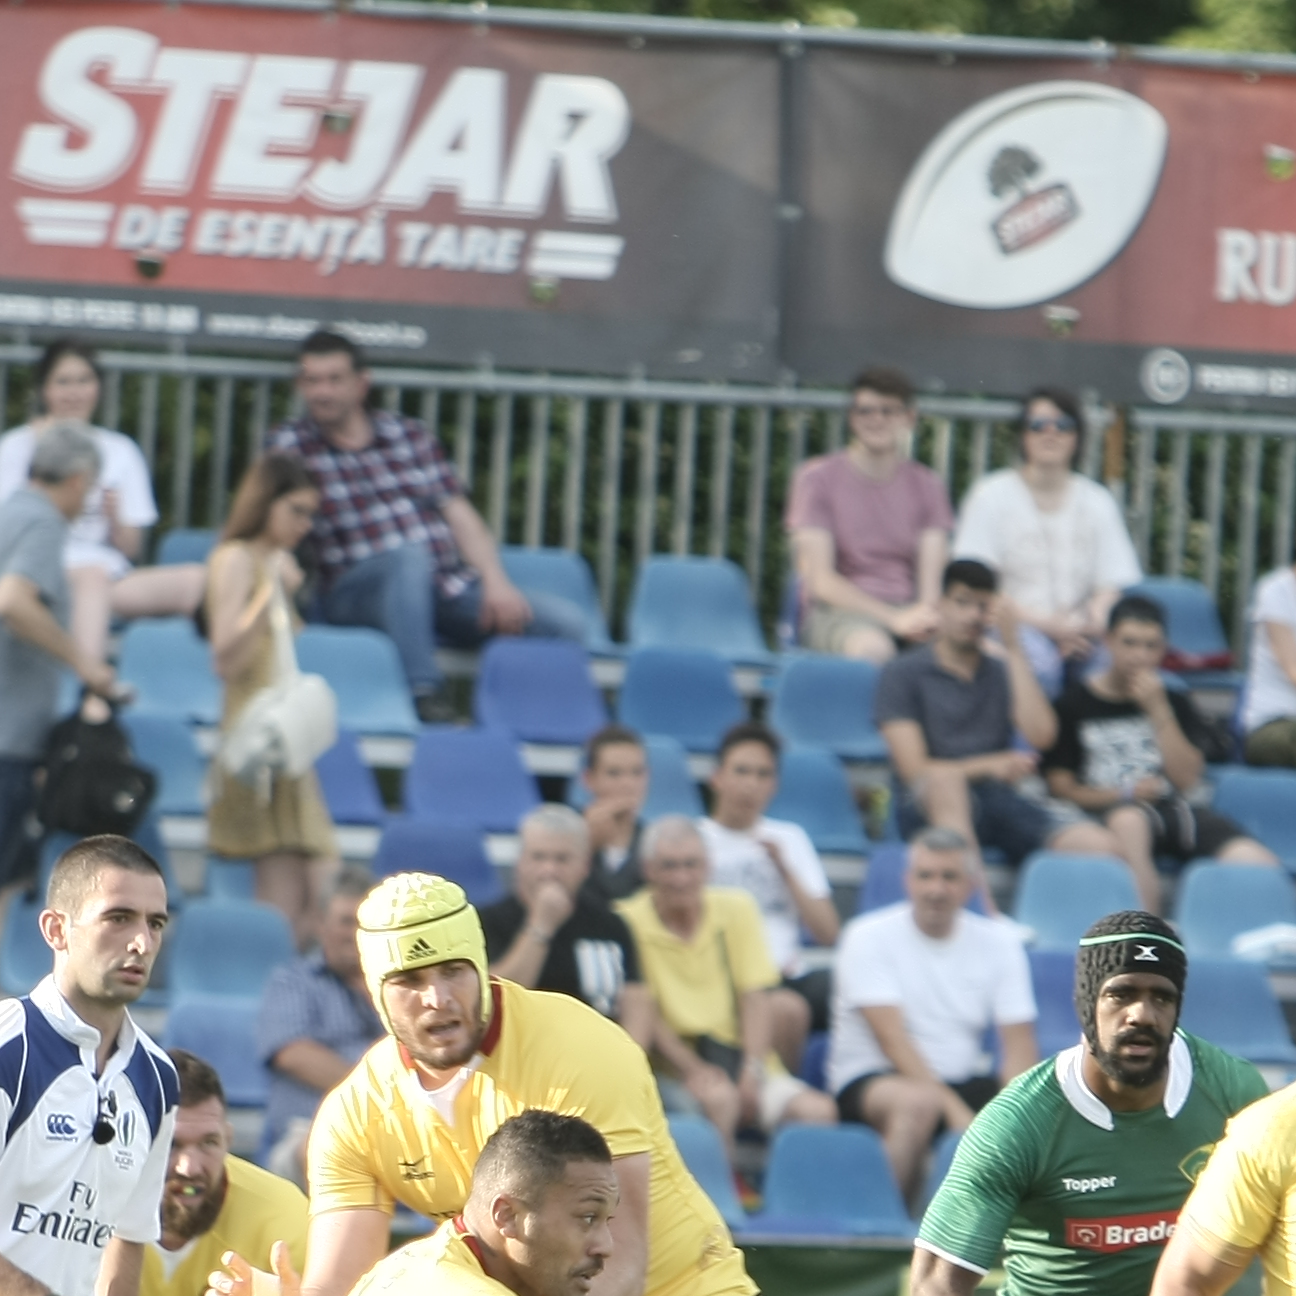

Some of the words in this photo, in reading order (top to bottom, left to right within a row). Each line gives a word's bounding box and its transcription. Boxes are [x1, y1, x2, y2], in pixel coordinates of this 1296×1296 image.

[11, 25, 632, 223] STEJAR
[114, 204, 192, 252] DE
[394, 223, 528, 273] TARE
[1062, 1175, 1117, 1193] Topper
